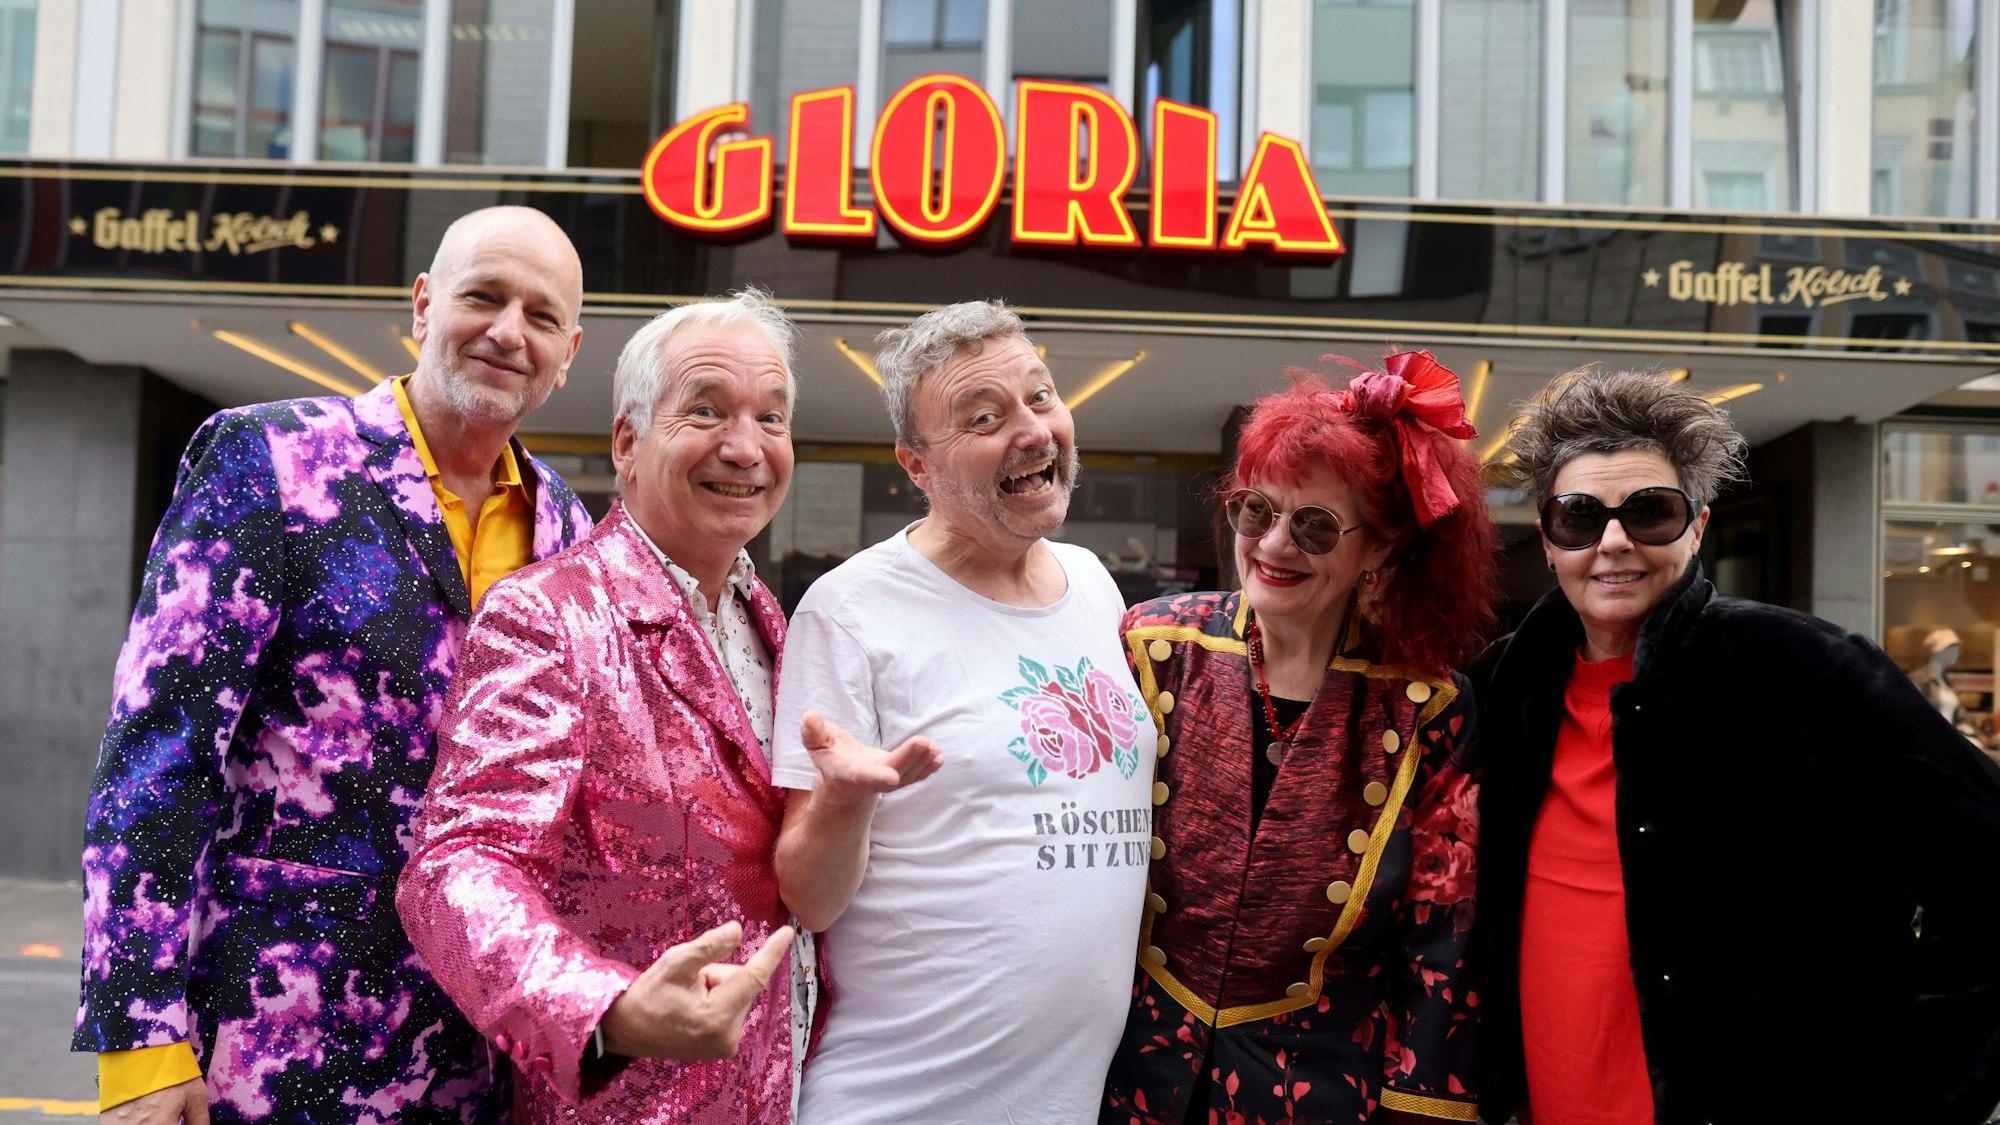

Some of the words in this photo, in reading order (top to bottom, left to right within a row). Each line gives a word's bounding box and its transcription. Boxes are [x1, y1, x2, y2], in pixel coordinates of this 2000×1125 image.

[641, 72, 1346, 256] GLORIA
[93, 207, 201, 254] Gaffel
[1668, 260, 1775, 306] Gaffel
[1779, 265, 1889, 308] Kölsch
